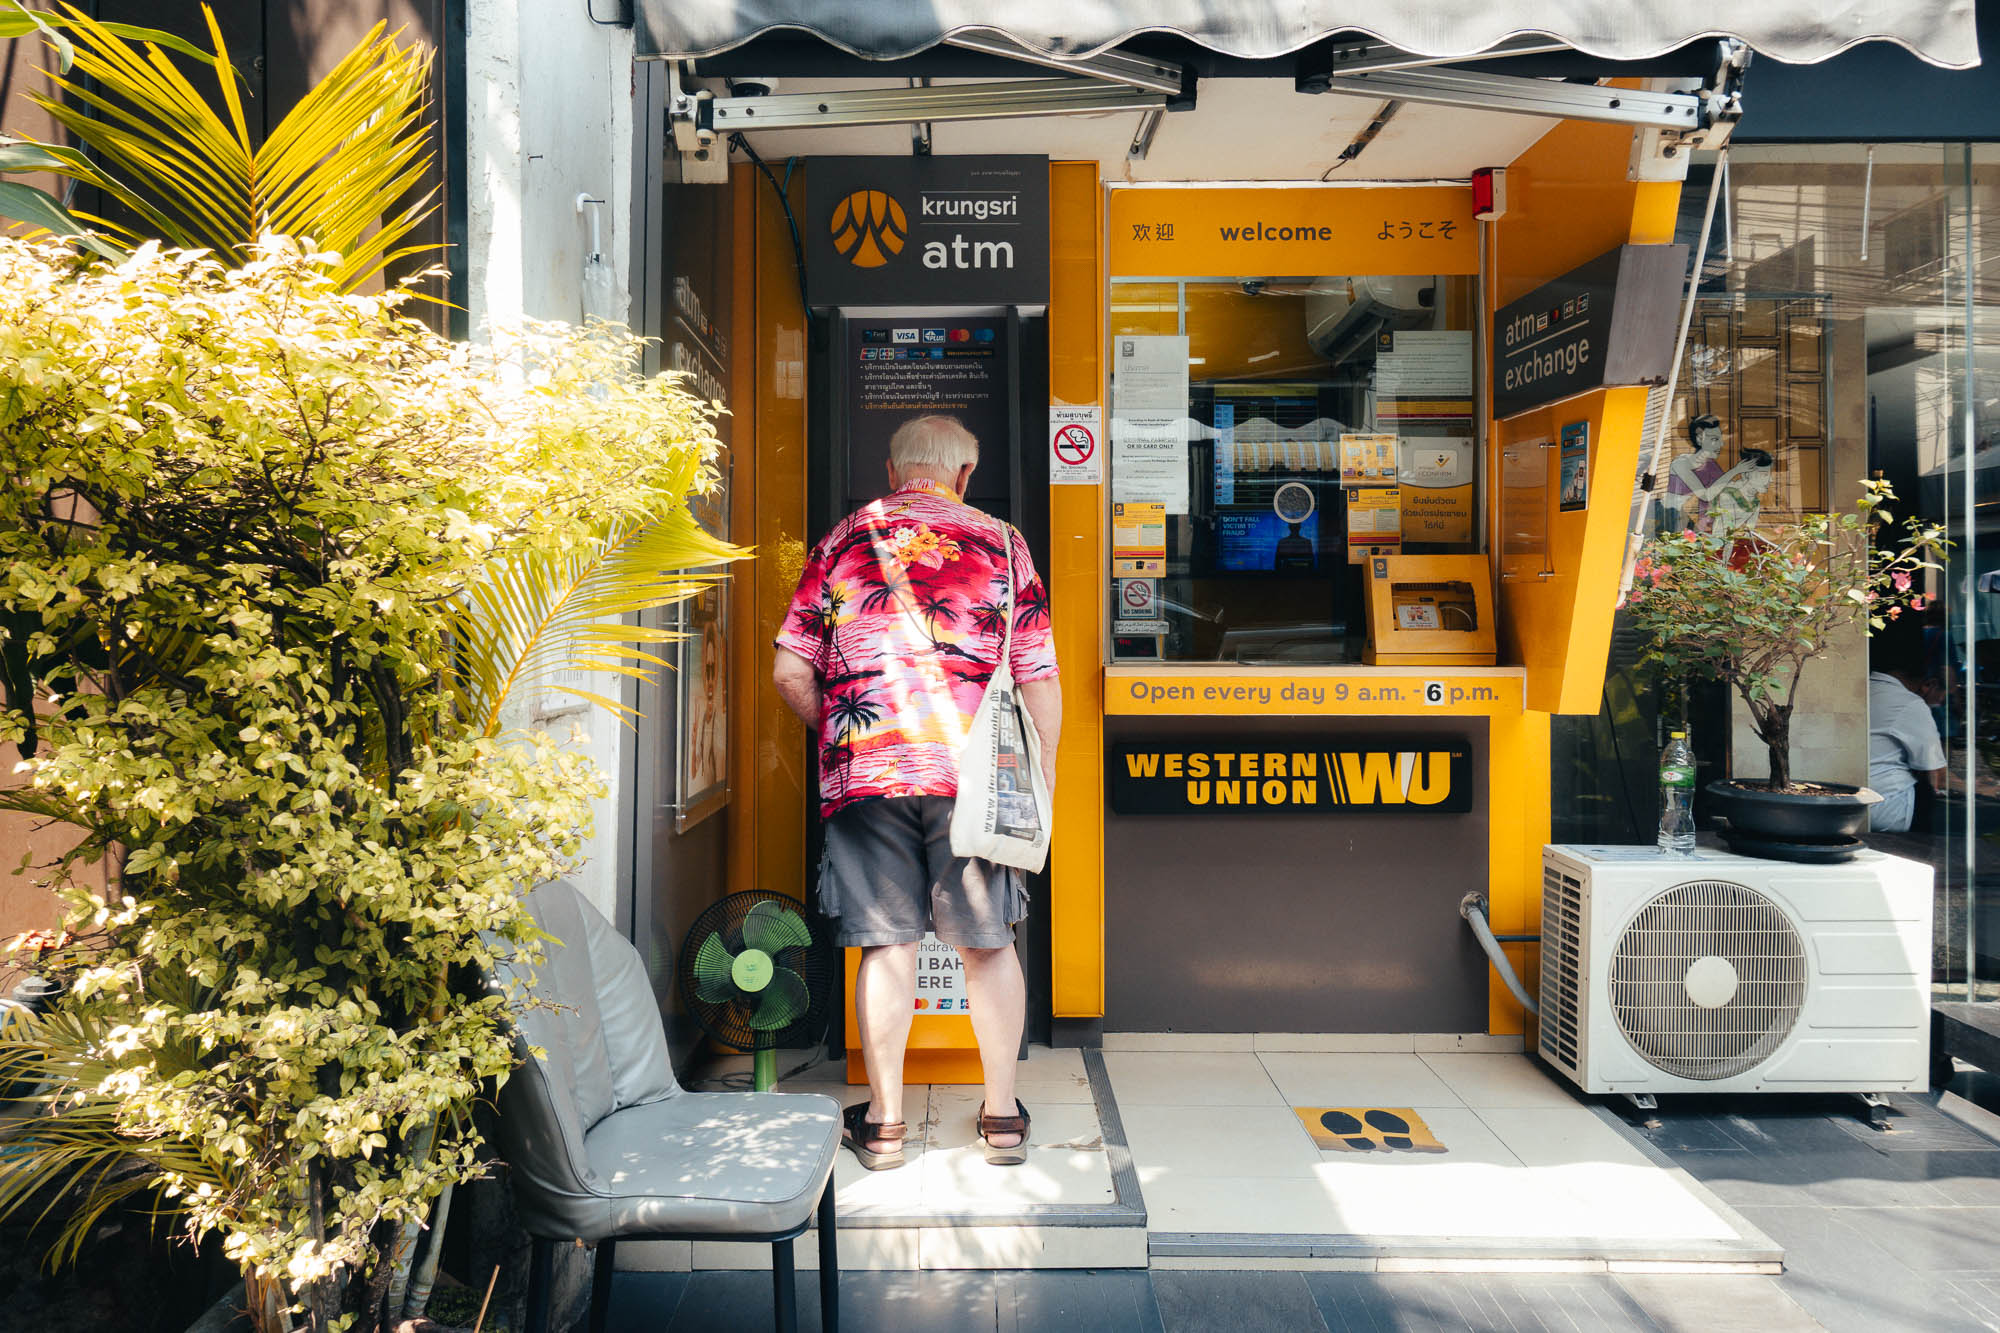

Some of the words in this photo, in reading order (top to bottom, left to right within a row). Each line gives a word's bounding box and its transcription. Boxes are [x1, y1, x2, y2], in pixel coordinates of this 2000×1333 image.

[922, 196, 1017, 220] krungsri
[1132, 223, 1175, 242] 欢迎
[1220, 222, 1332, 242] welcome
[1377, 220, 1458, 241] ようこそ
[922, 234, 1014, 269] atm
[678, 276, 701, 327] atm
[896, 332, 916, 340] VISA
[1505, 312, 1535, 347] atm
[1505, 337, 1590, 391] exchange
[1056, 409, 1093, 421] ห้ามสูบบุหรี่
[1130, 681, 1195, 704] Open
[1203, 684, 1272, 705] every
[1280, 682, 1325, 705] day
[1334, 683, 1349, 701] 9
[1358, 686, 1406, 701] a.m.
[1427, 683, 1442, 702] 6
[1450, 686, 1499, 704] p.m.
[1126, 753, 1317, 778] WESTERN
[1339, 751, 1451, 806] WU
[1187, 780, 1317, 805] UNION
[929, 958, 963, 970] BAH
[918, 976, 953, 989] ERE
